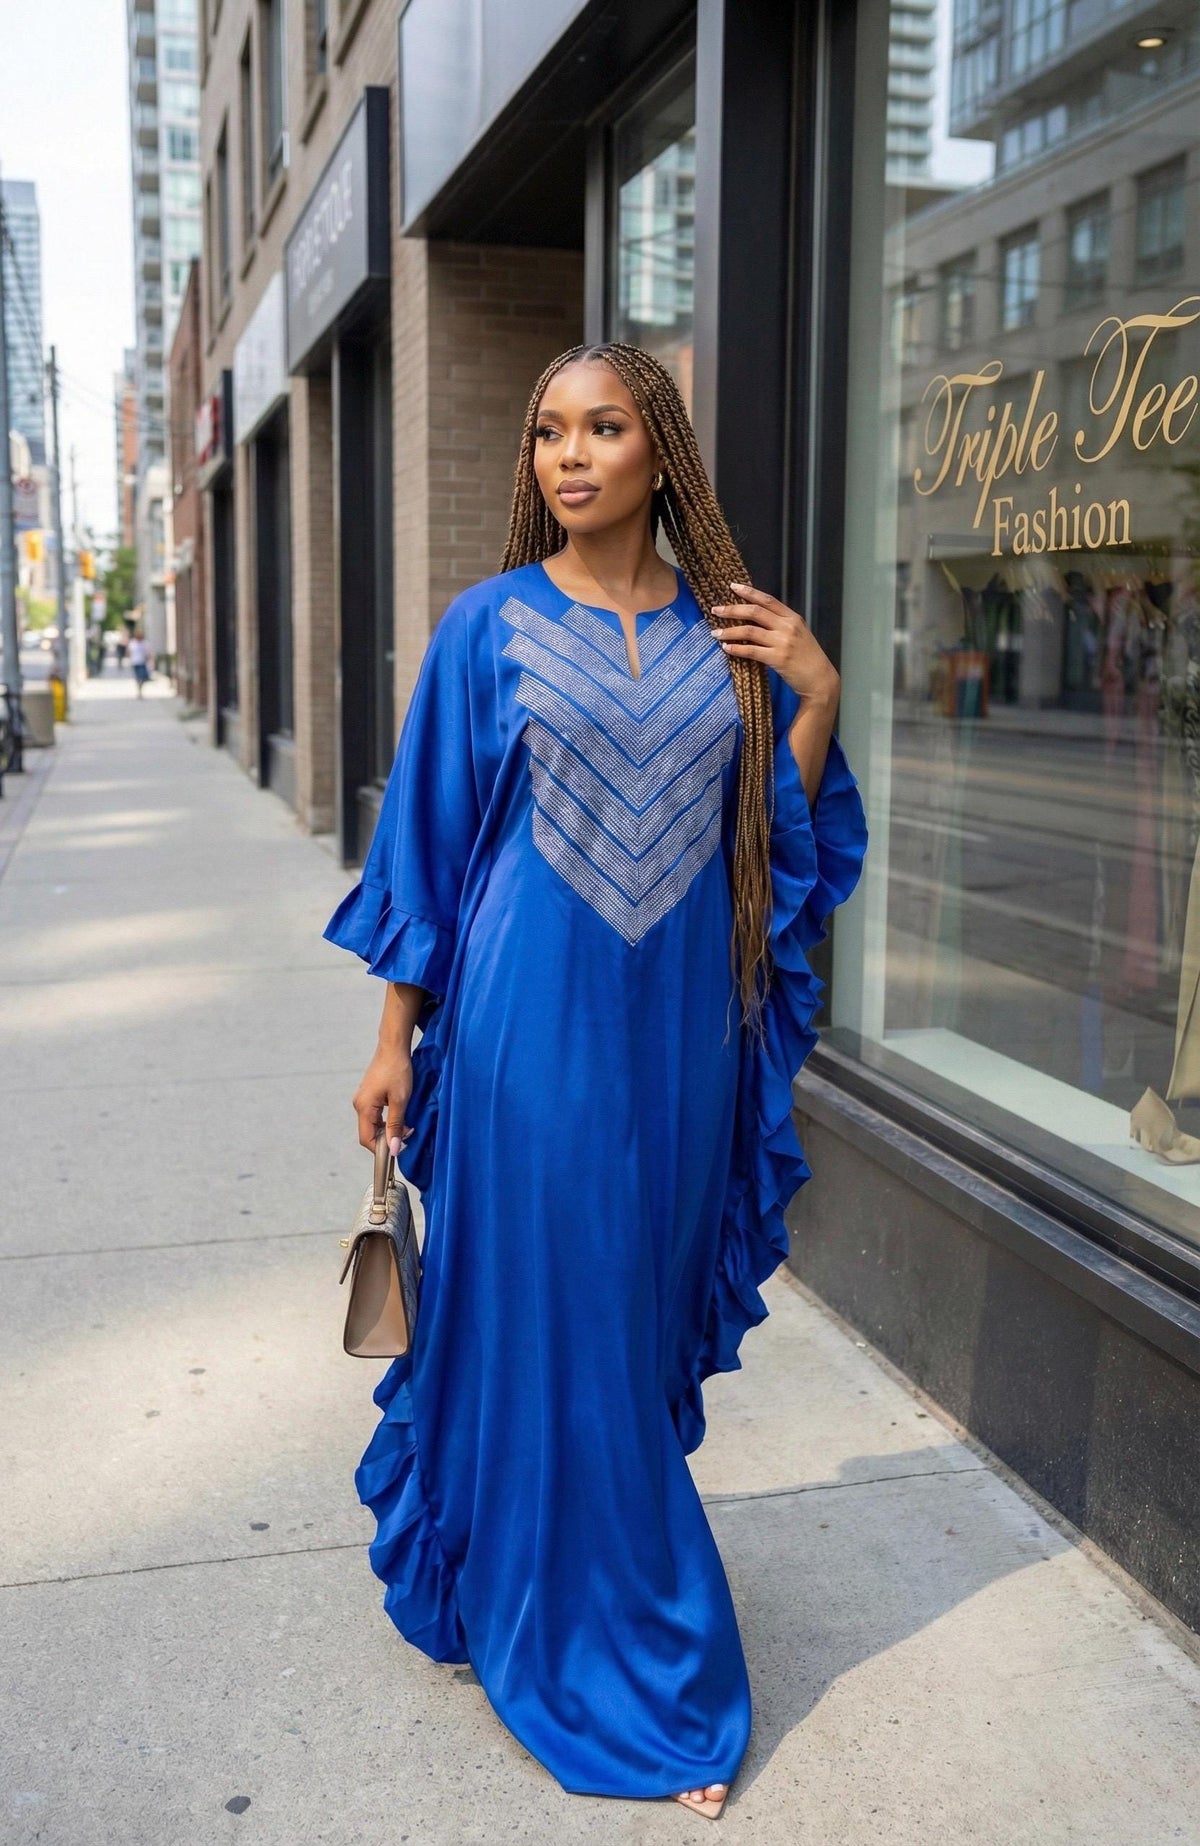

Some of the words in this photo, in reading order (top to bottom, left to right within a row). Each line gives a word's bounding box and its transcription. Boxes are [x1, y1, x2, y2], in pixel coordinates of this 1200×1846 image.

[914, 360, 1058, 528] Triple
[1075, 295, 1200, 463] Tee
[991, 482, 1132, 557] Fashion
